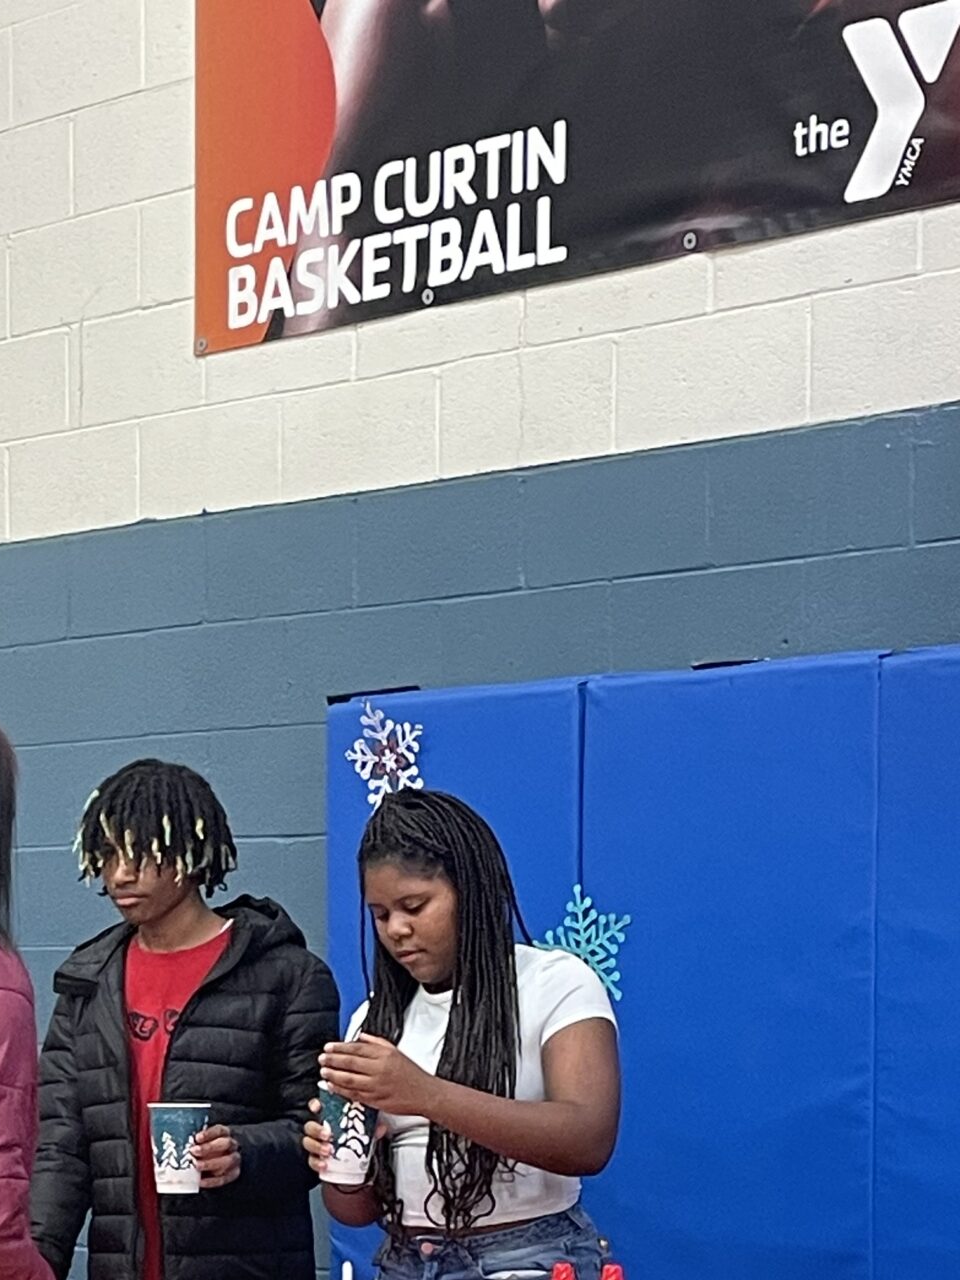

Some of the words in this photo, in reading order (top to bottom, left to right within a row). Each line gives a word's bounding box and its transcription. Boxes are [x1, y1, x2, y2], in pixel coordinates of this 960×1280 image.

[793, 114, 850, 157] the
[895, 137, 925, 187] YMCA
[226, 172, 362, 258] CAMP
[373, 119, 567, 225] CURTIN
[228, 196, 568, 330] BASKETBALL
